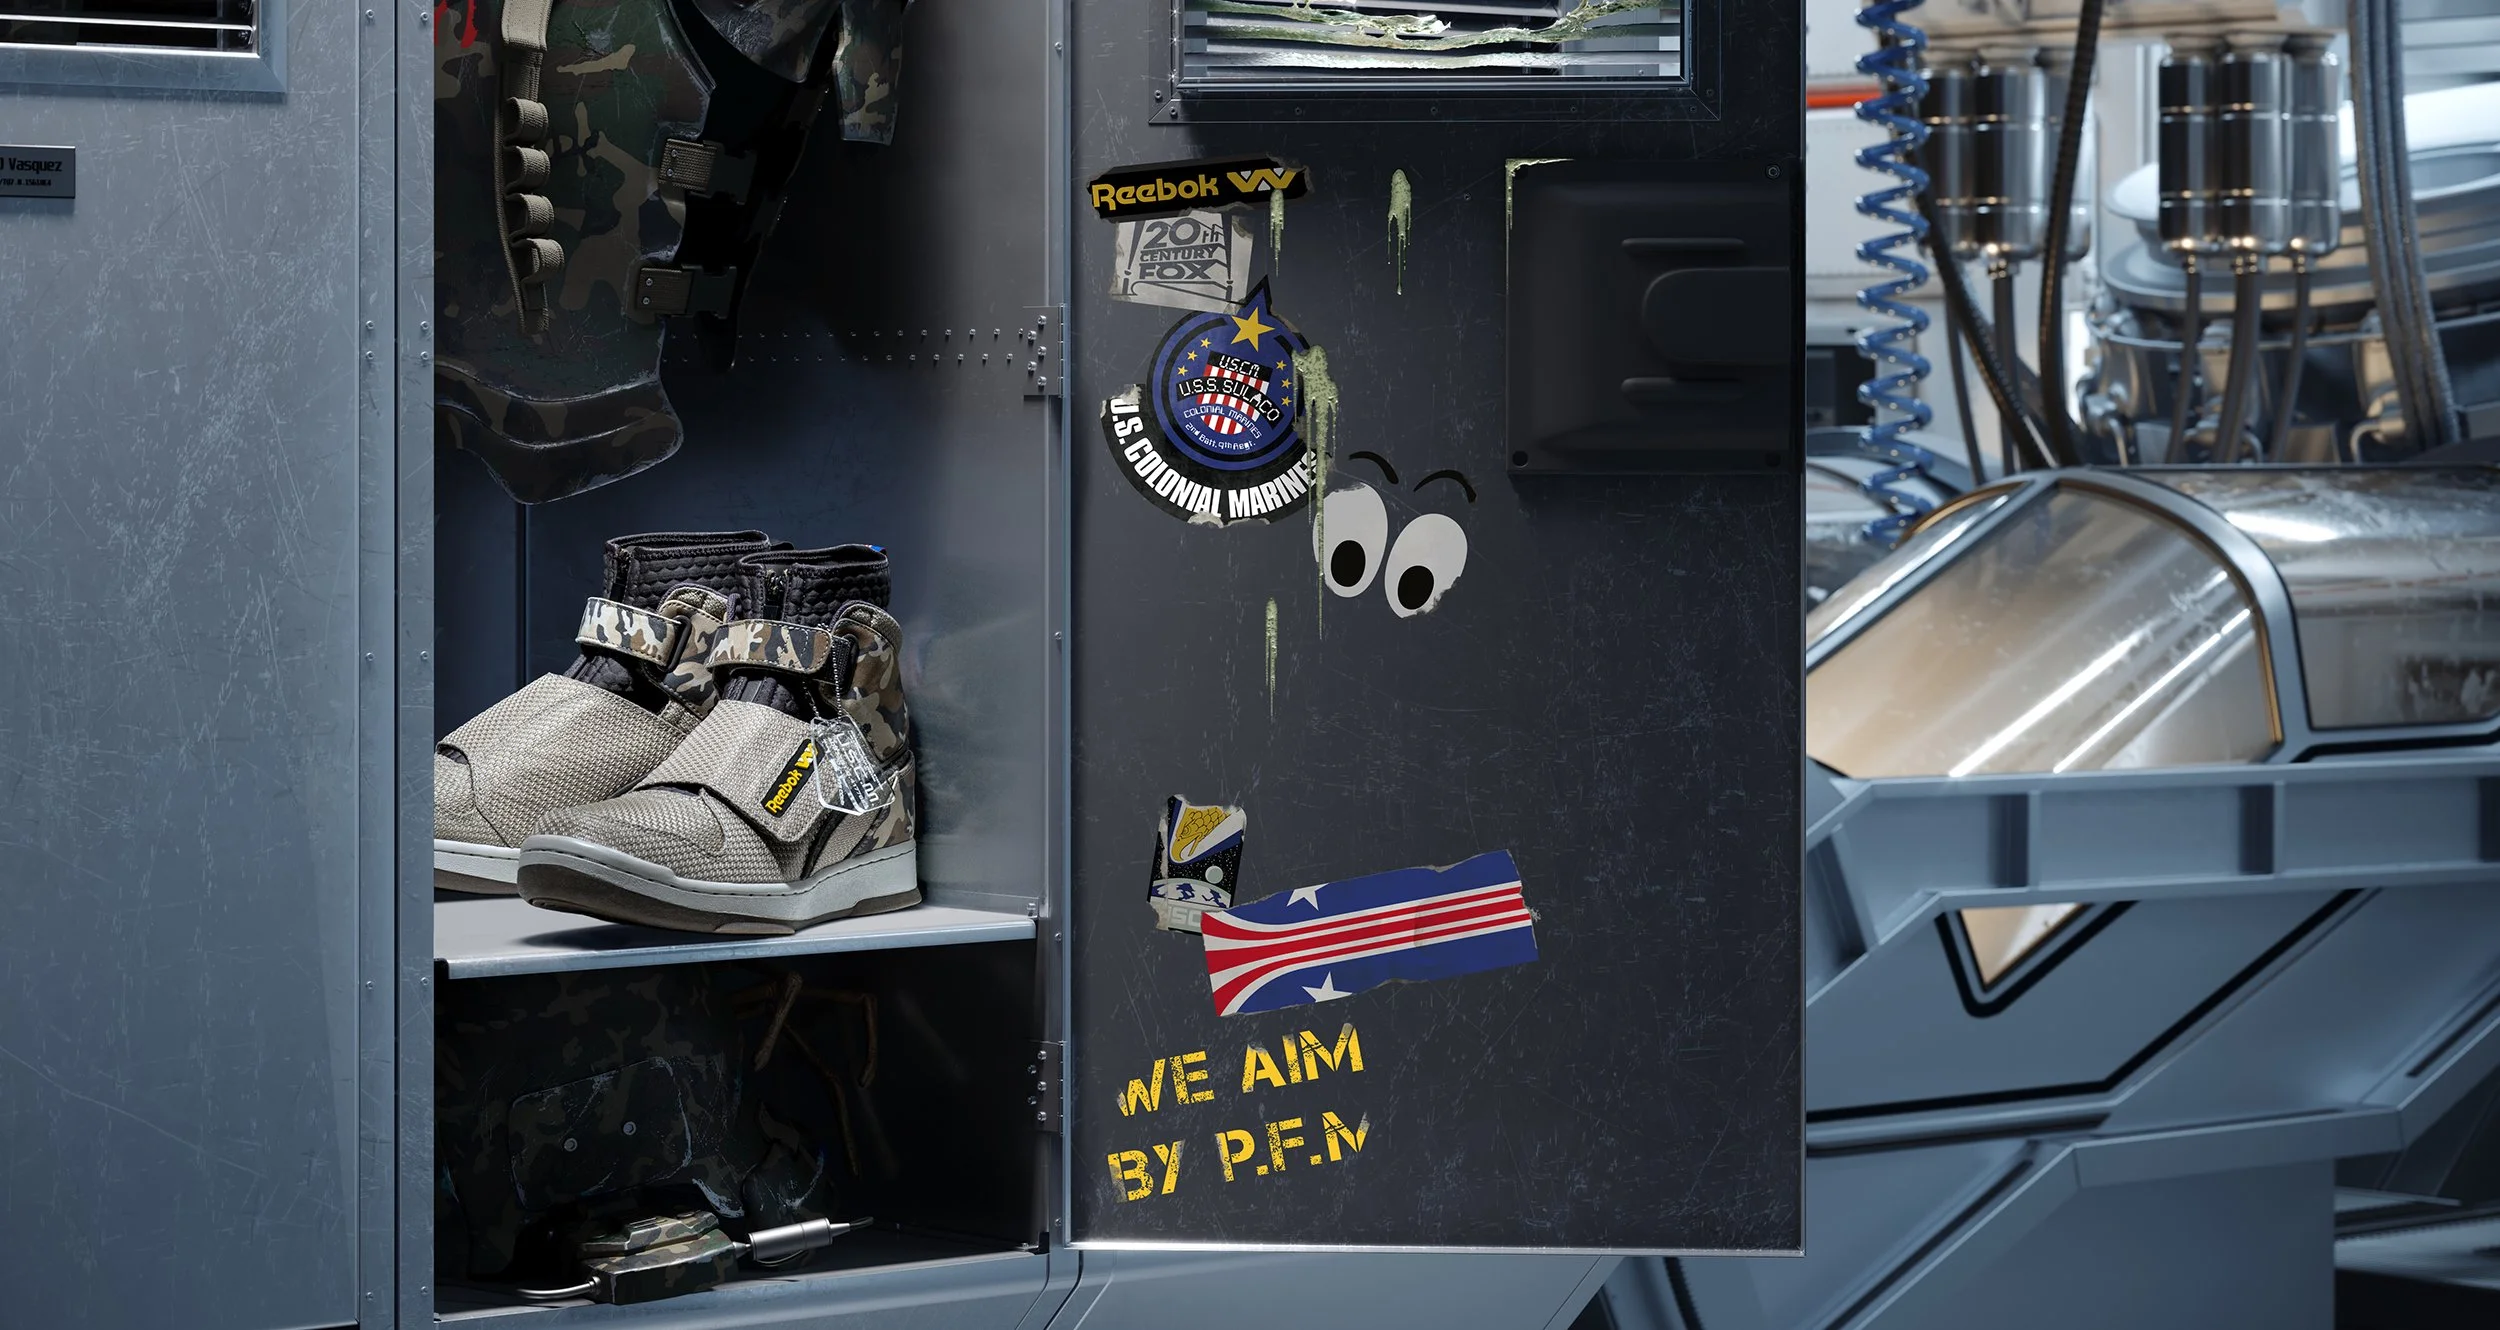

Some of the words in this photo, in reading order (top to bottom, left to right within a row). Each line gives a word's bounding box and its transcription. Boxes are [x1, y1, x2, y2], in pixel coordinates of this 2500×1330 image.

[8, 157, 63, 174] Vasquez
[1091, 174, 1219, 211] Reebok
[1139, 247, 1216, 263] CENTURY
[1139, 261, 1212, 280] FOX
[1179, 378, 1219, 397] U.S.S.
[1222, 379, 1280, 421] SULACO
[1110, 398, 1144, 446] U.S.
[1183, 405, 1225, 419] COLONIAL
[1228, 409, 1262, 439] MARINES
[1123, 437, 1222, 518] COLONIAL
[765, 769, 803, 815] Reebok
[1117, 1050, 1215, 1117] WE
[1242, 1023, 1365, 1094] AIM
[1107, 1139, 1185, 1202] BY
